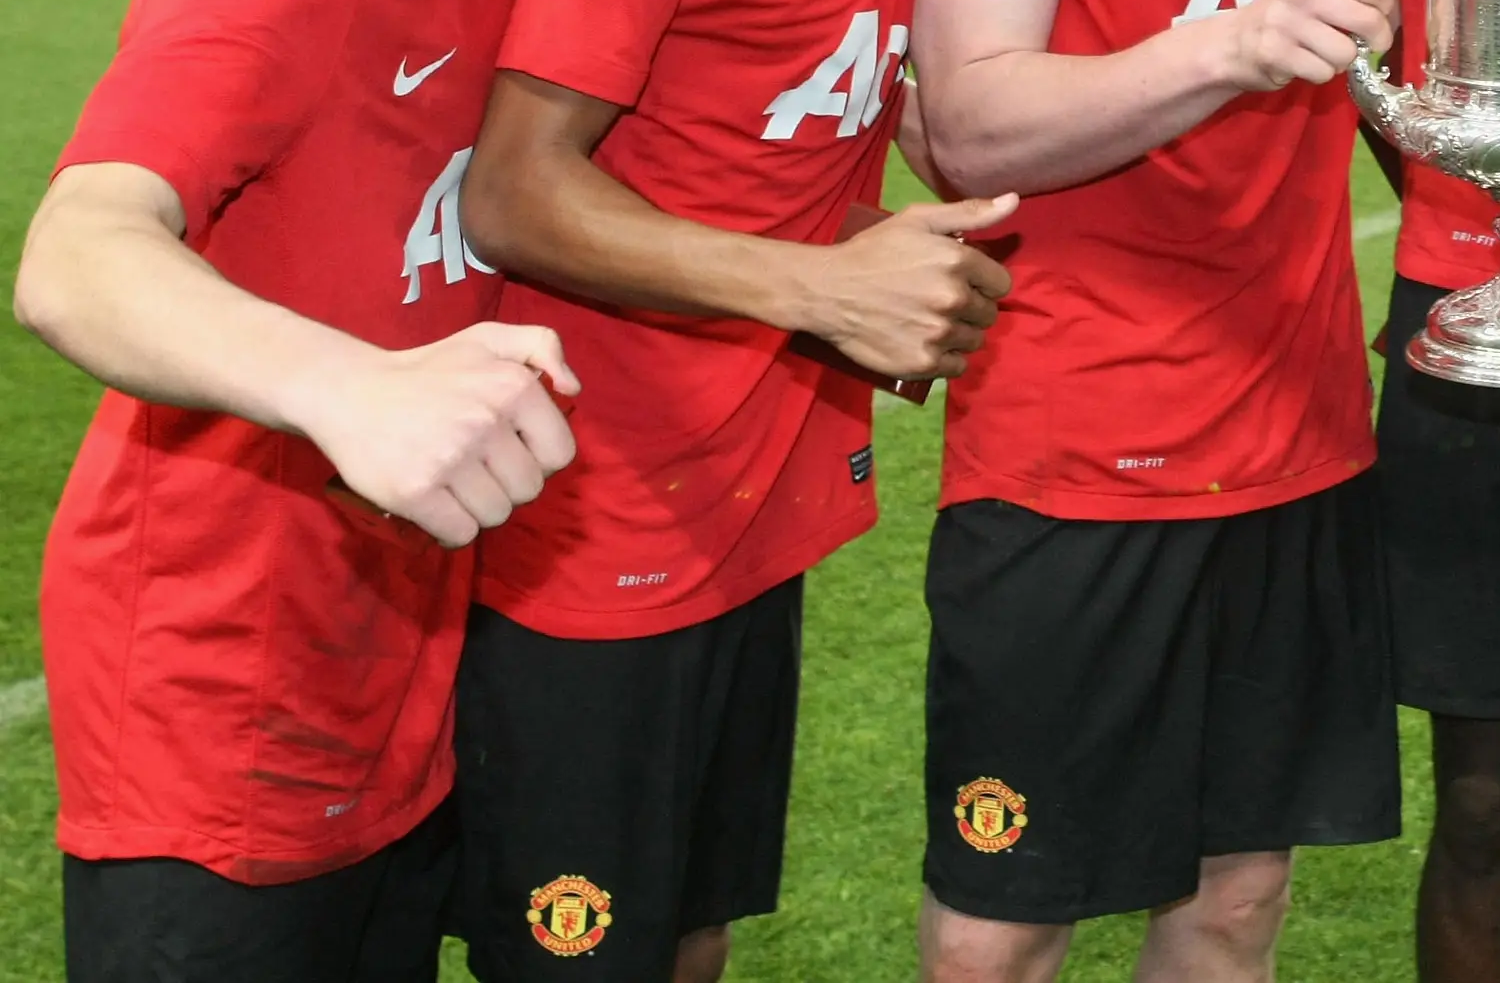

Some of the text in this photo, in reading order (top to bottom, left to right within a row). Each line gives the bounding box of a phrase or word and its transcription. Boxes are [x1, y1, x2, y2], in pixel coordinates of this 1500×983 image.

[1452, 230, 1496, 247] DRI-FIT
[1117, 458, 1165, 469] DRI-FIT
[617, 573, 667, 587] DRI-FIT
[961, 783, 1019, 810] MANCHESTER
[967, 832, 1010, 848] UNITED
[538, 880, 606, 905] MANCHESTER
[543, 935, 592, 951] UNITED
